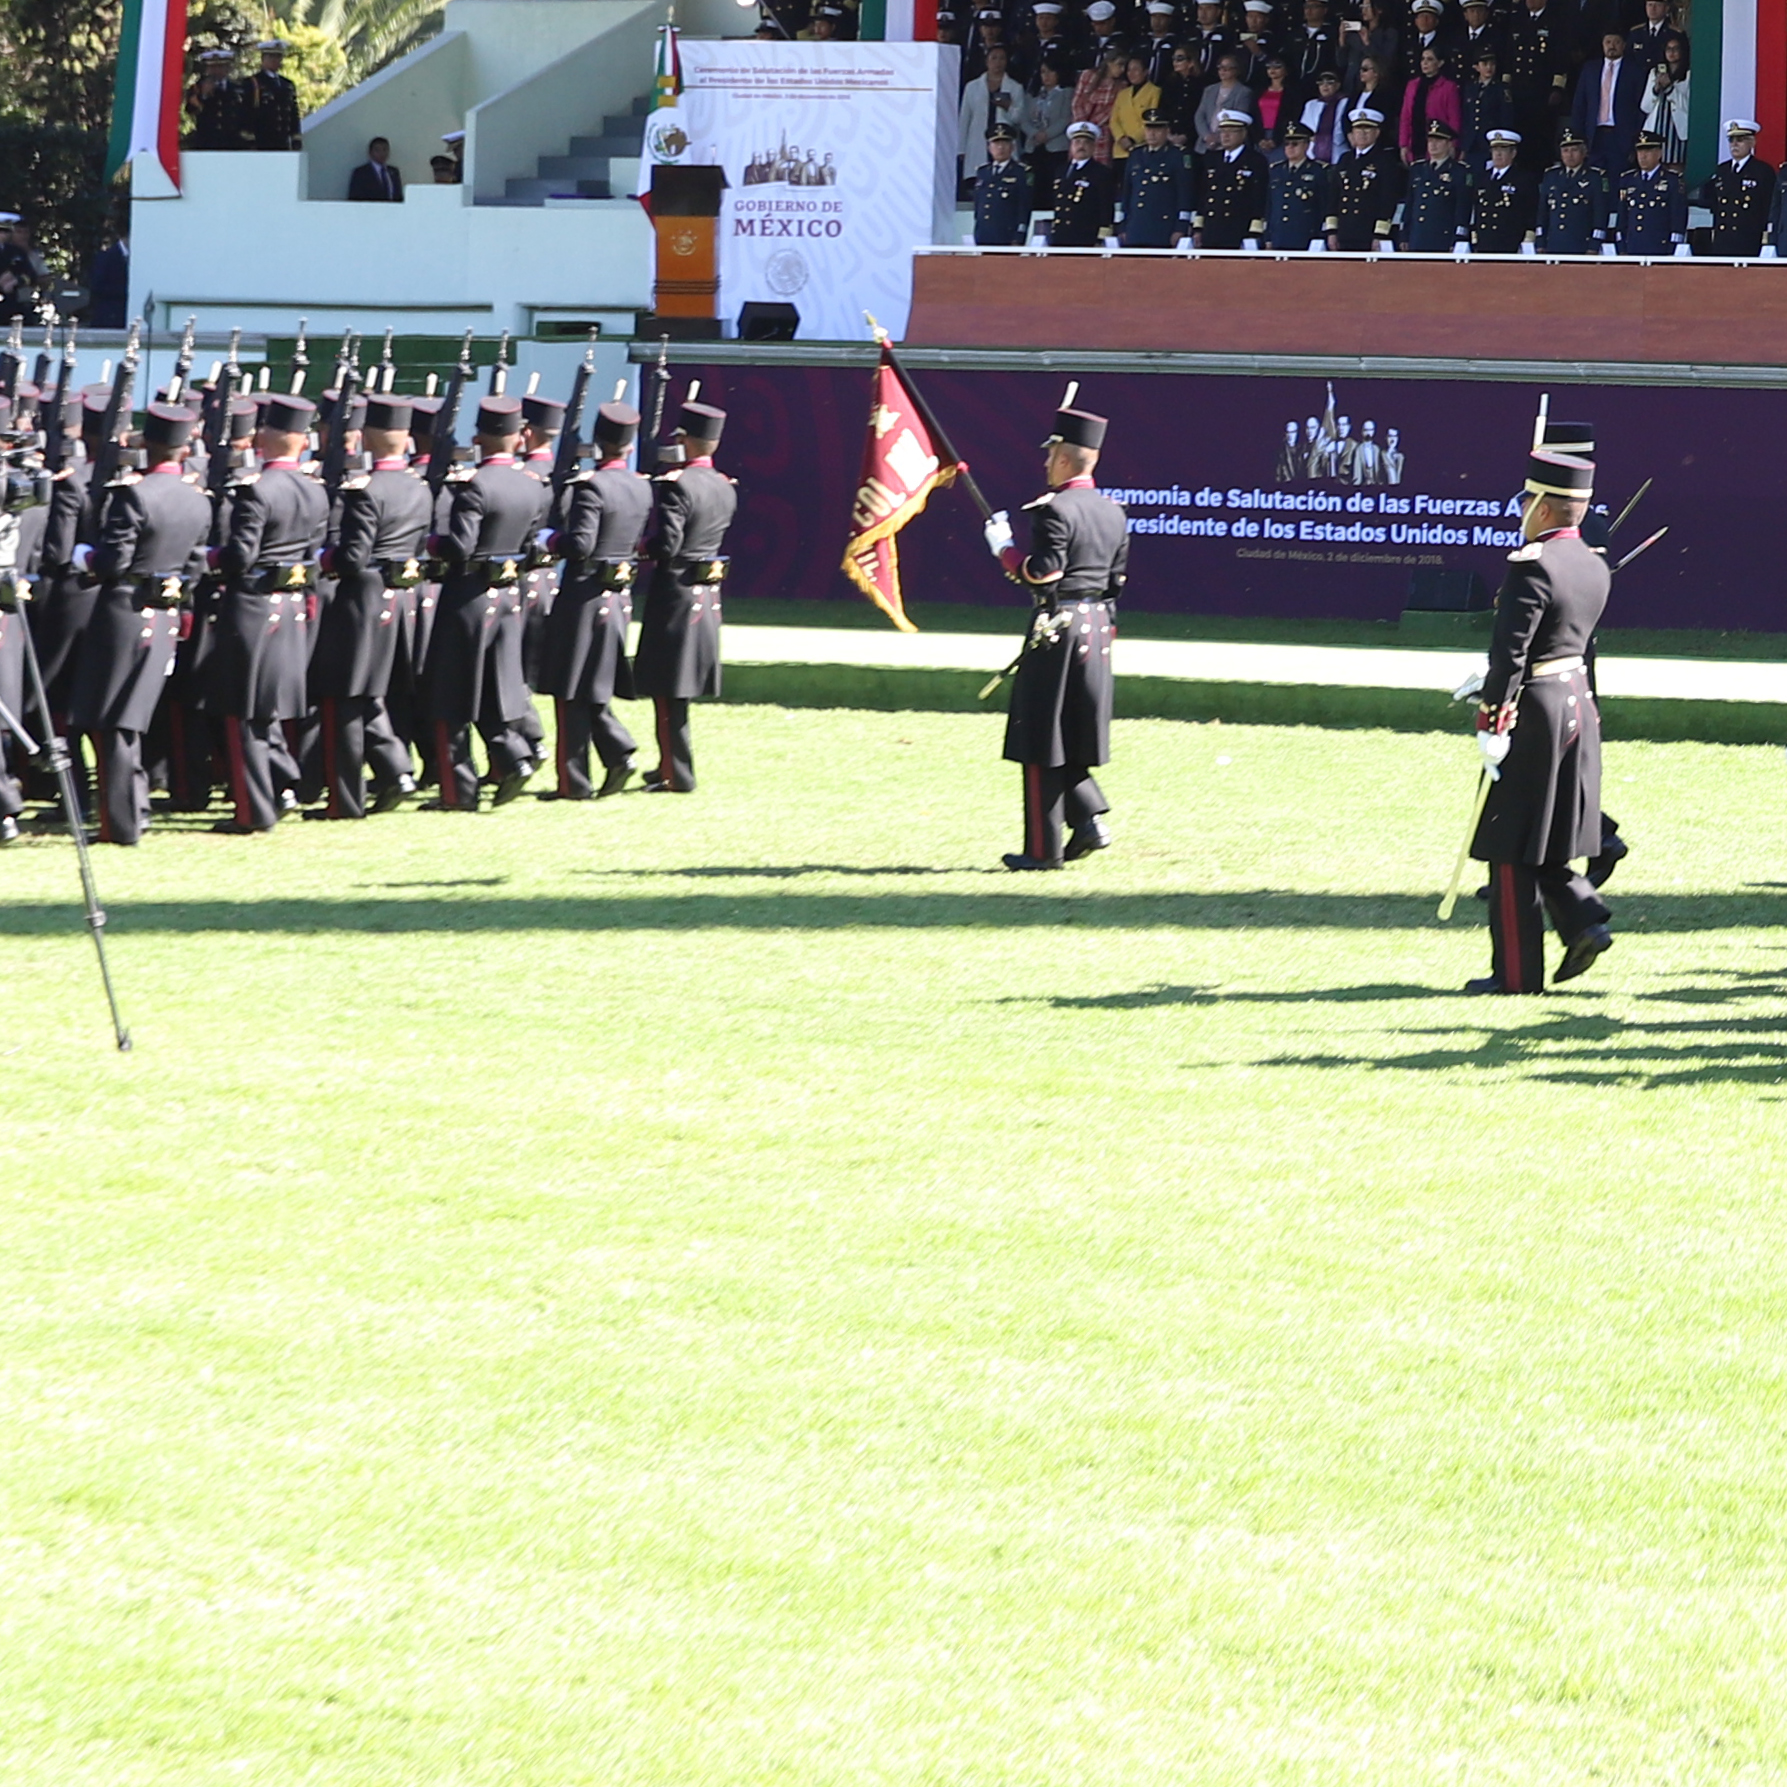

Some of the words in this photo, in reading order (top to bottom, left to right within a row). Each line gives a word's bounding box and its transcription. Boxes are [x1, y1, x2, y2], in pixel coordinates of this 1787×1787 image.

[734, 200, 818, 212] GOBIERNO
[821, 201, 843, 213] DE
[733, 212, 842, 238] MÉXICO
[1194, 486, 1223, 508] de
[1226, 488, 1342, 512] Salutación
[1345, 491, 1377, 513] de
[1379, 492, 1410, 515] las
[1414, 494, 1501, 517] Fuerzas
[1126, 513, 1228, 536] residente
[1231, 516, 1260, 538] de
[1263, 518, 1296, 540] los
[1299, 520, 1388, 543] Estados
[1390, 523, 1468, 546] Unidos
[1236, 547, 1272, 559] Ciudad
[1273, 549, 1287, 560] de
[1326, 551, 1333, 562] 2
[1334, 552, 1349, 562] de
[1349, 552, 1402, 564] diciembre
[1403, 554, 1417, 565] de
